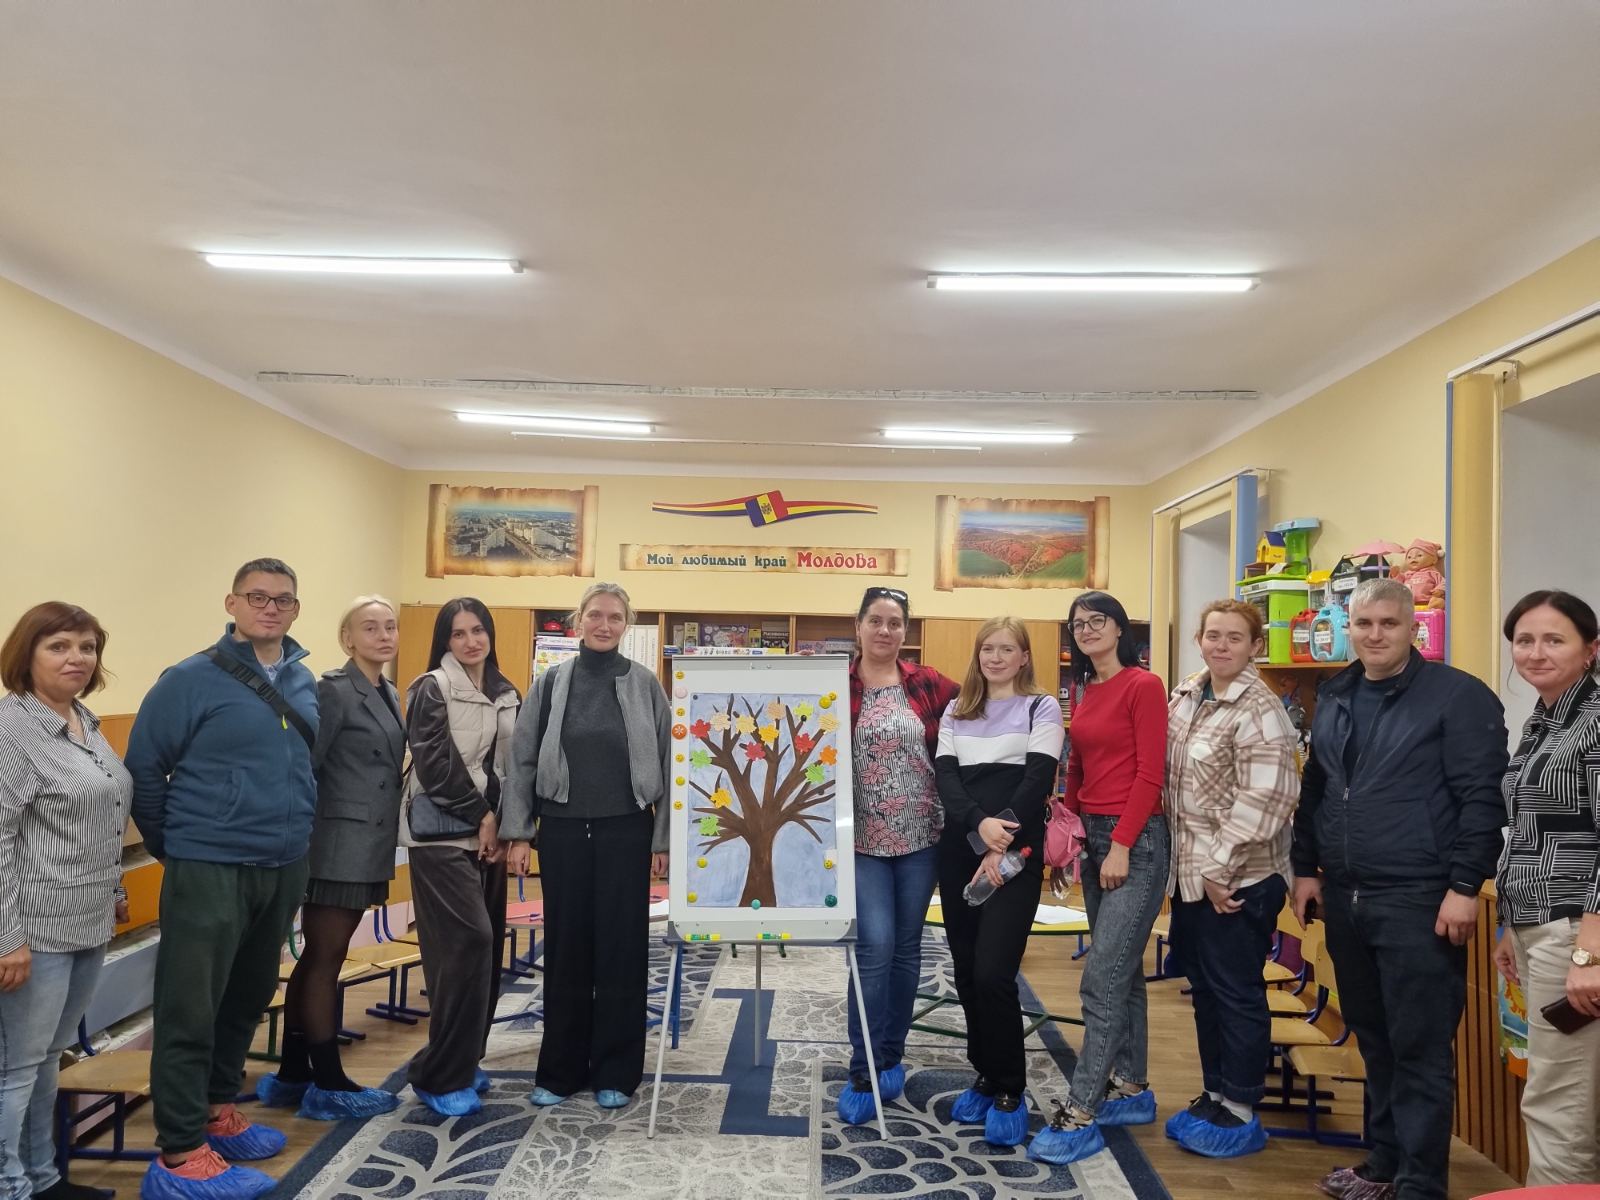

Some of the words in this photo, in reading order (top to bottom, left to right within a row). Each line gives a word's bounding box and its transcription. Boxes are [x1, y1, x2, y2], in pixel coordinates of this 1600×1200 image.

[647, 554, 674, 565] Мой
[682, 554, 747, 567] любимый
[755, 555, 787, 570] край
[797, 551, 878, 569] Молдова
